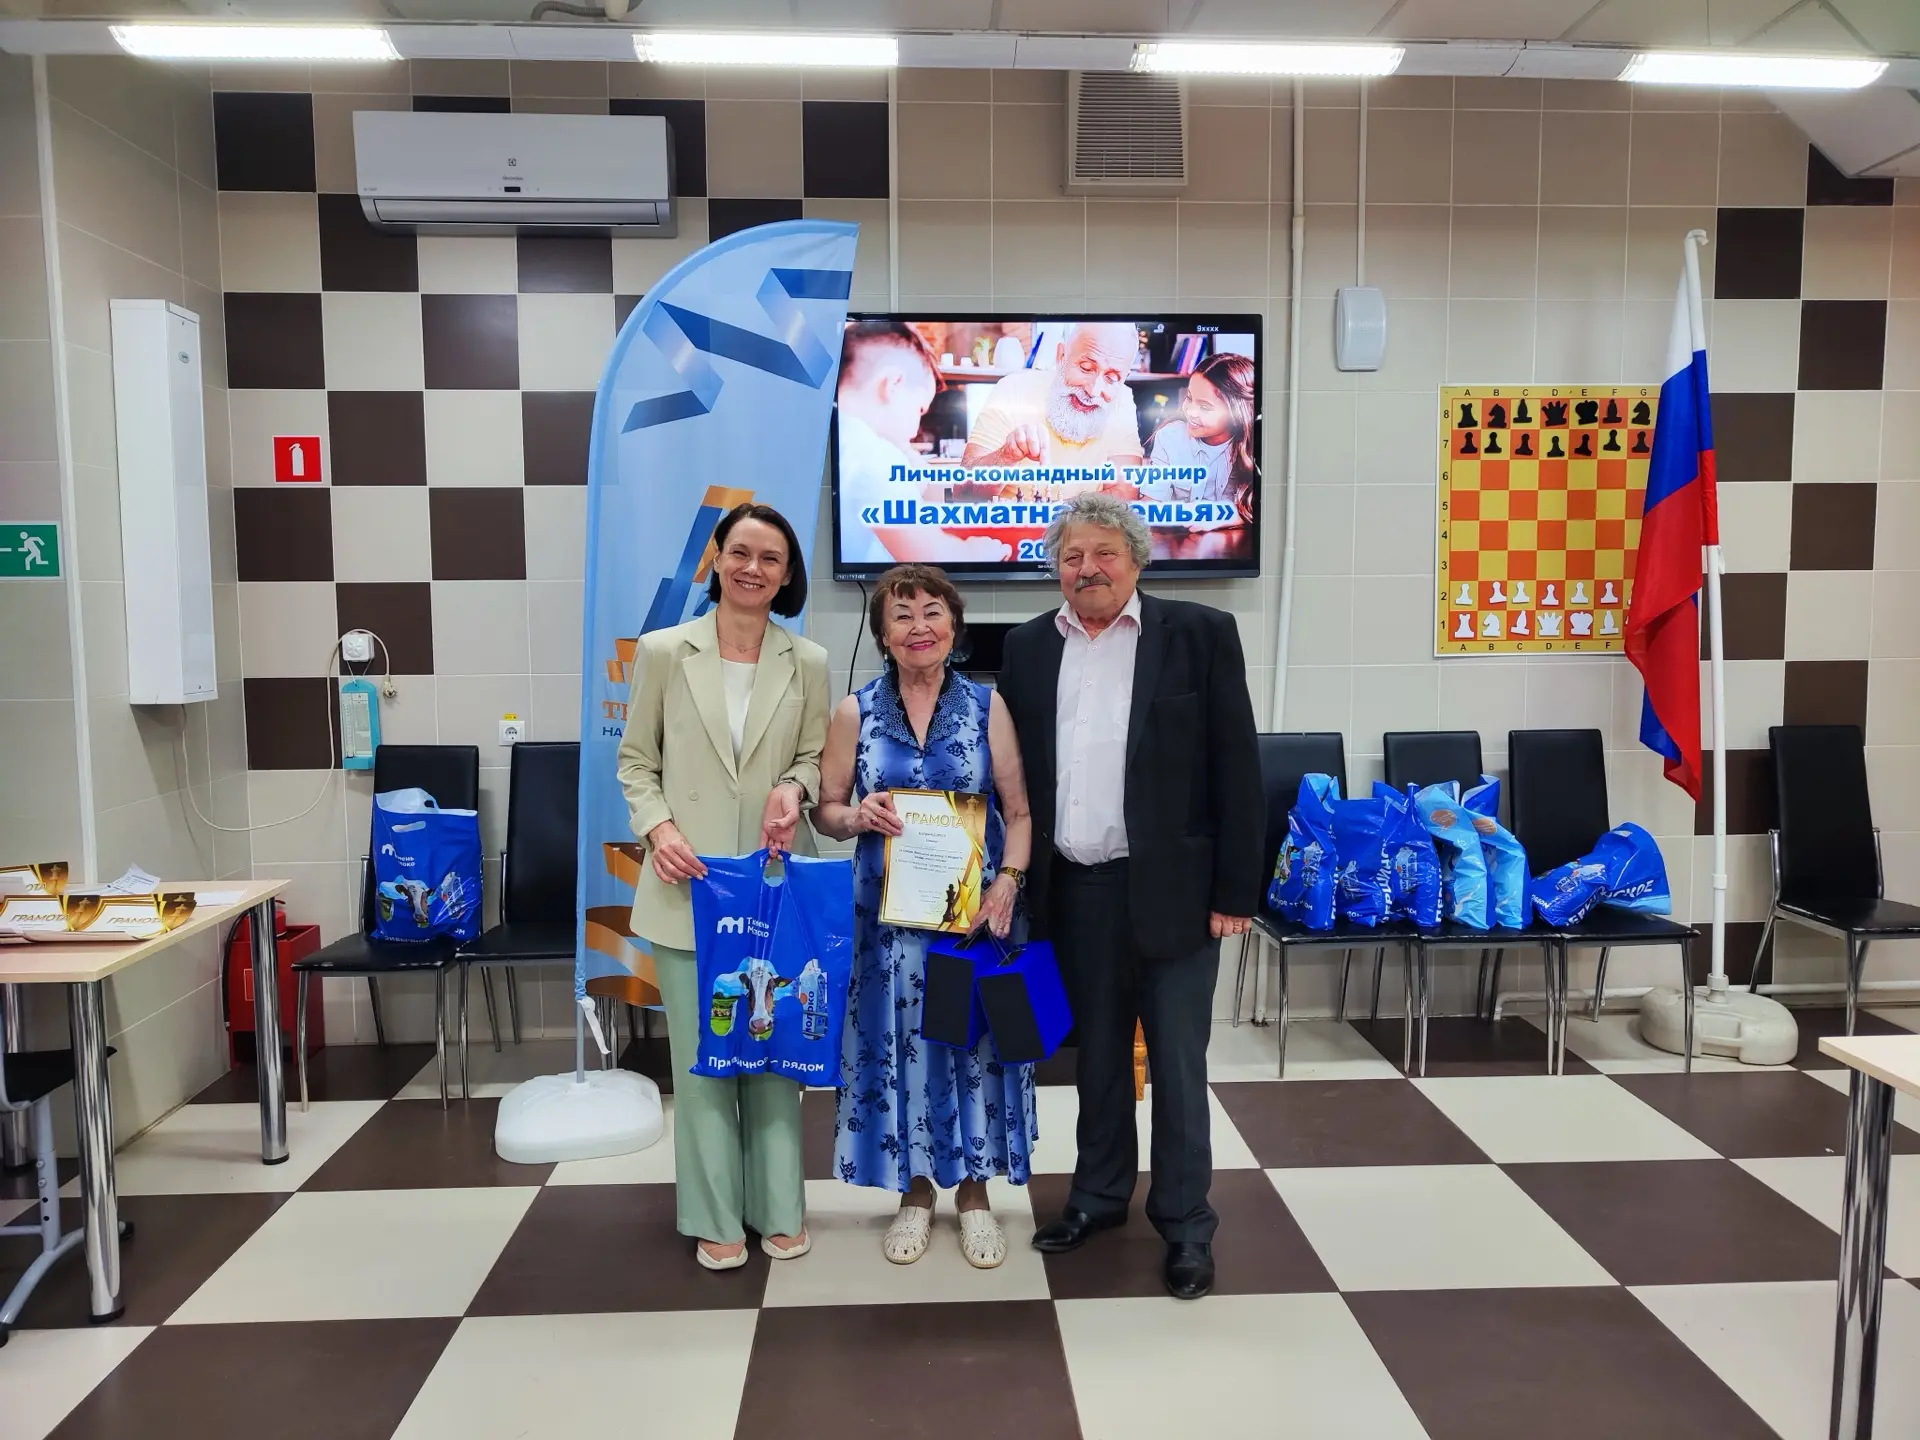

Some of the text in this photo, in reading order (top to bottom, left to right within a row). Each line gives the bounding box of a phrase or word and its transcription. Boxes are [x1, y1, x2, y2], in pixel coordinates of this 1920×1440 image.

[1463, 388, 1647, 397] A B C D E F G
[1443, 409, 1450, 419] 8
[1442, 439, 1449, 449] 7
[889, 464, 1207, 484] Лично-командный турнир
[1442, 471, 1449, 481] 6
[1442, 501, 1449, 511] 5
[861, 499, 1235, 525] «Шахматна емья»
[1441, 530, 1448, 540] 4
[1020, 542, 1047, 560] 20
[1441, 560, 1448, 571] 3
[1440, 591, 1447, 601] 2
[1440, 620, 1446, 630] 1
[1459, 641, 1612, 651] A B C D E F
[905, 811, 967, 828] ГРАМОТА
[782, 1060, 824, 1072] рядом
